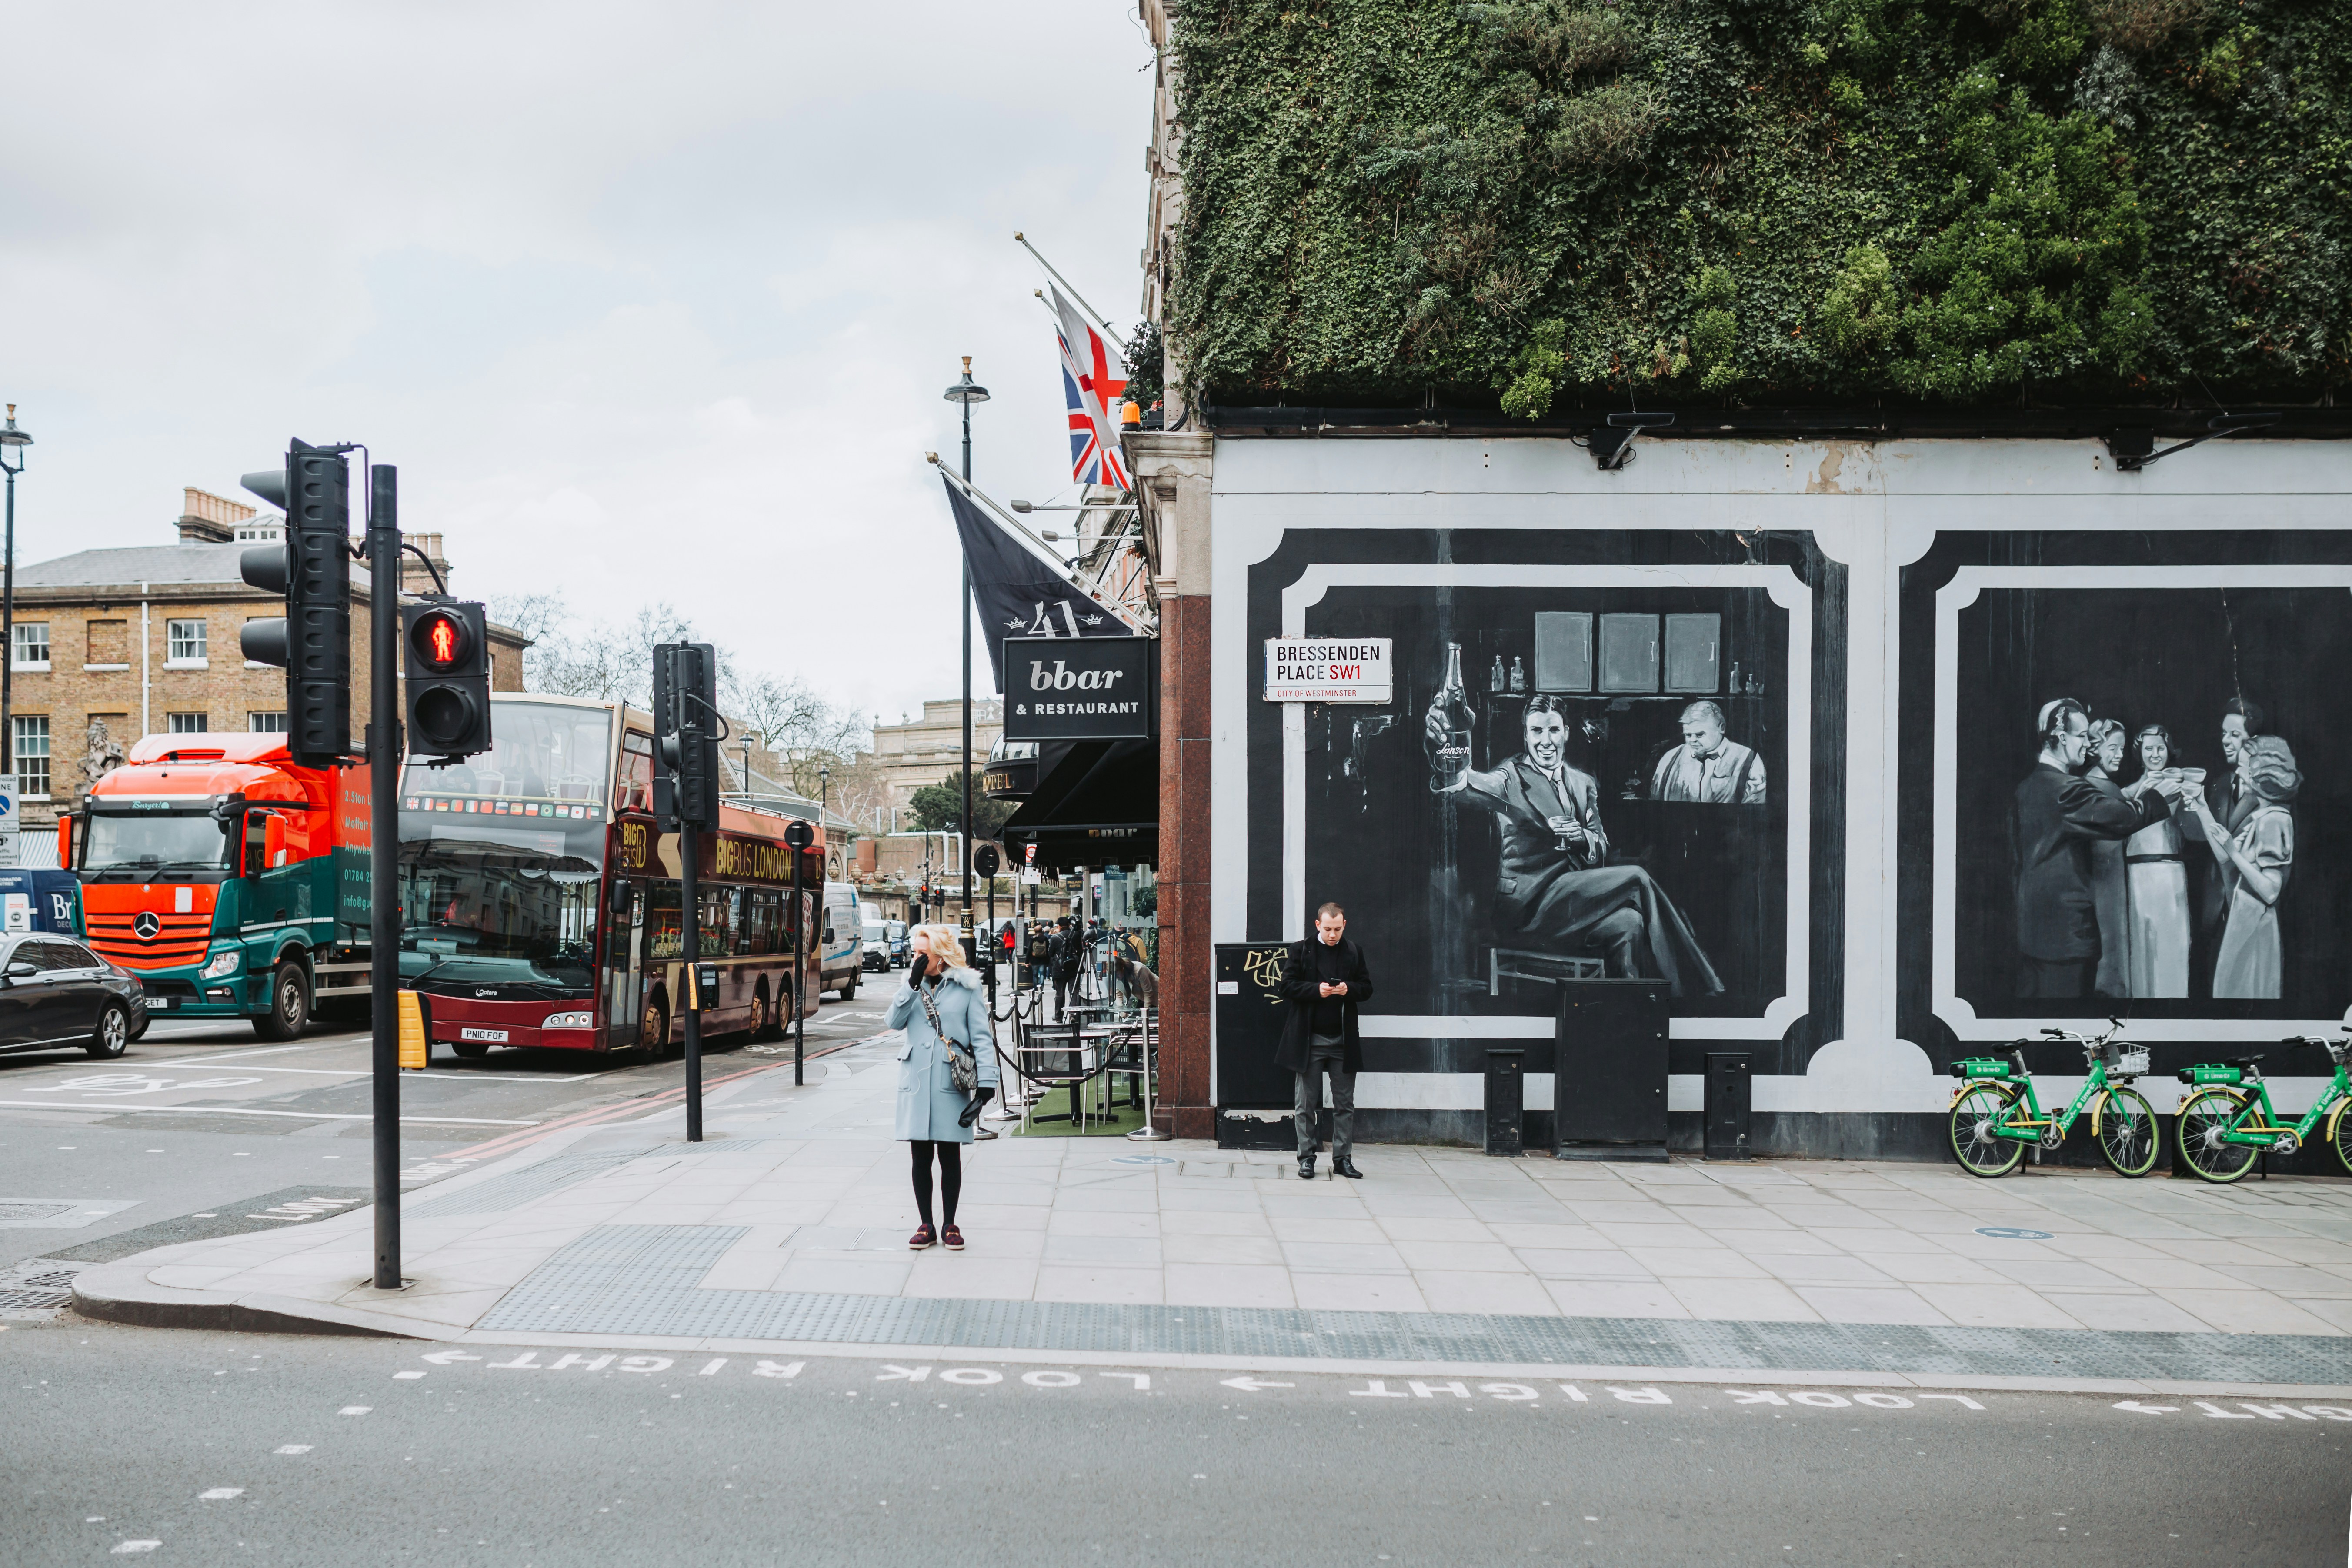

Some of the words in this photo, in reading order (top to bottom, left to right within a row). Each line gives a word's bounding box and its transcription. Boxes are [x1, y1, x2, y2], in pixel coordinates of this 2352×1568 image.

[1278, 646, 1380, 661] BRESSENDEN
[1030, 660, 1123, 691] bbar
[1278, 665, 1324, 680] PLACE
[1330, 665, 1360, 680] SW1
[1016, 704, 1027, 715] &
[1035, 702, 1138, 714] RESTAURANT
[1436, 742, 1470, 754] Lanson
[345, 790, 365, 804] 2.5ton
[345, 816, 368, 831] Moffett
[624, 823, 637, 846] BIG
[754, 844, 791, 881] LONDON
[344, 869, 363, 882] 01784
[51, 894, 75, 919] Br
[487, 1031, 503, 1040] FOF
[486, 1351, 806, 1378] RIGHT
[875, 1364, 1150, 1390] LOOK
[1349, 1380, 1673, 1404] RIGHT
[1725, 1390, 1986, 1410] LOOK
